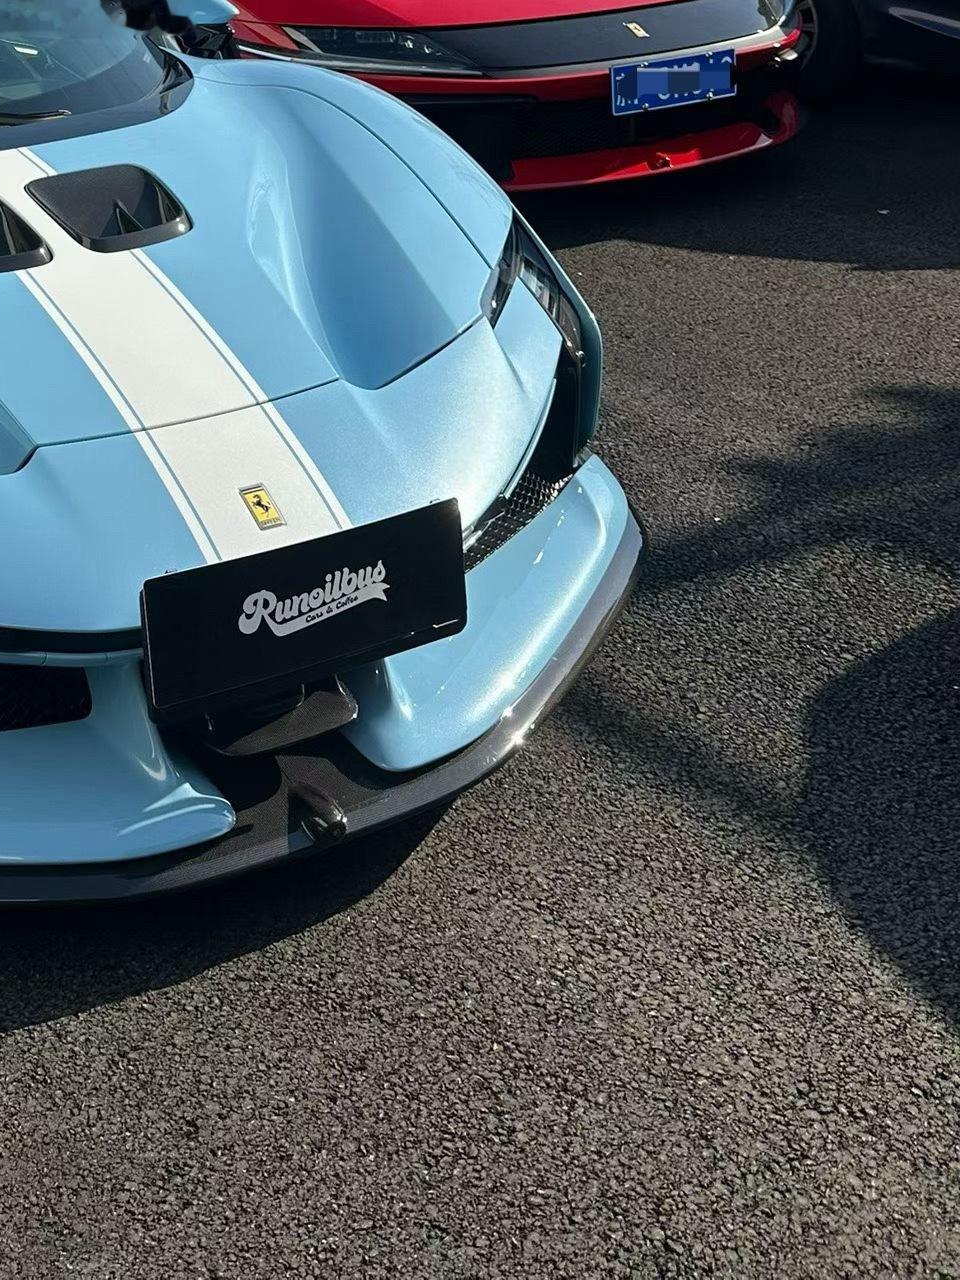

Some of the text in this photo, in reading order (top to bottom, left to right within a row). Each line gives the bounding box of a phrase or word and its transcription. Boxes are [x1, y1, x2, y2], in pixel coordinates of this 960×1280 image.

[238, 560, 386, 634] Runoilbus
[305, 612, 323, 623] Cars
[336, 595, 358, 609] Coffee
